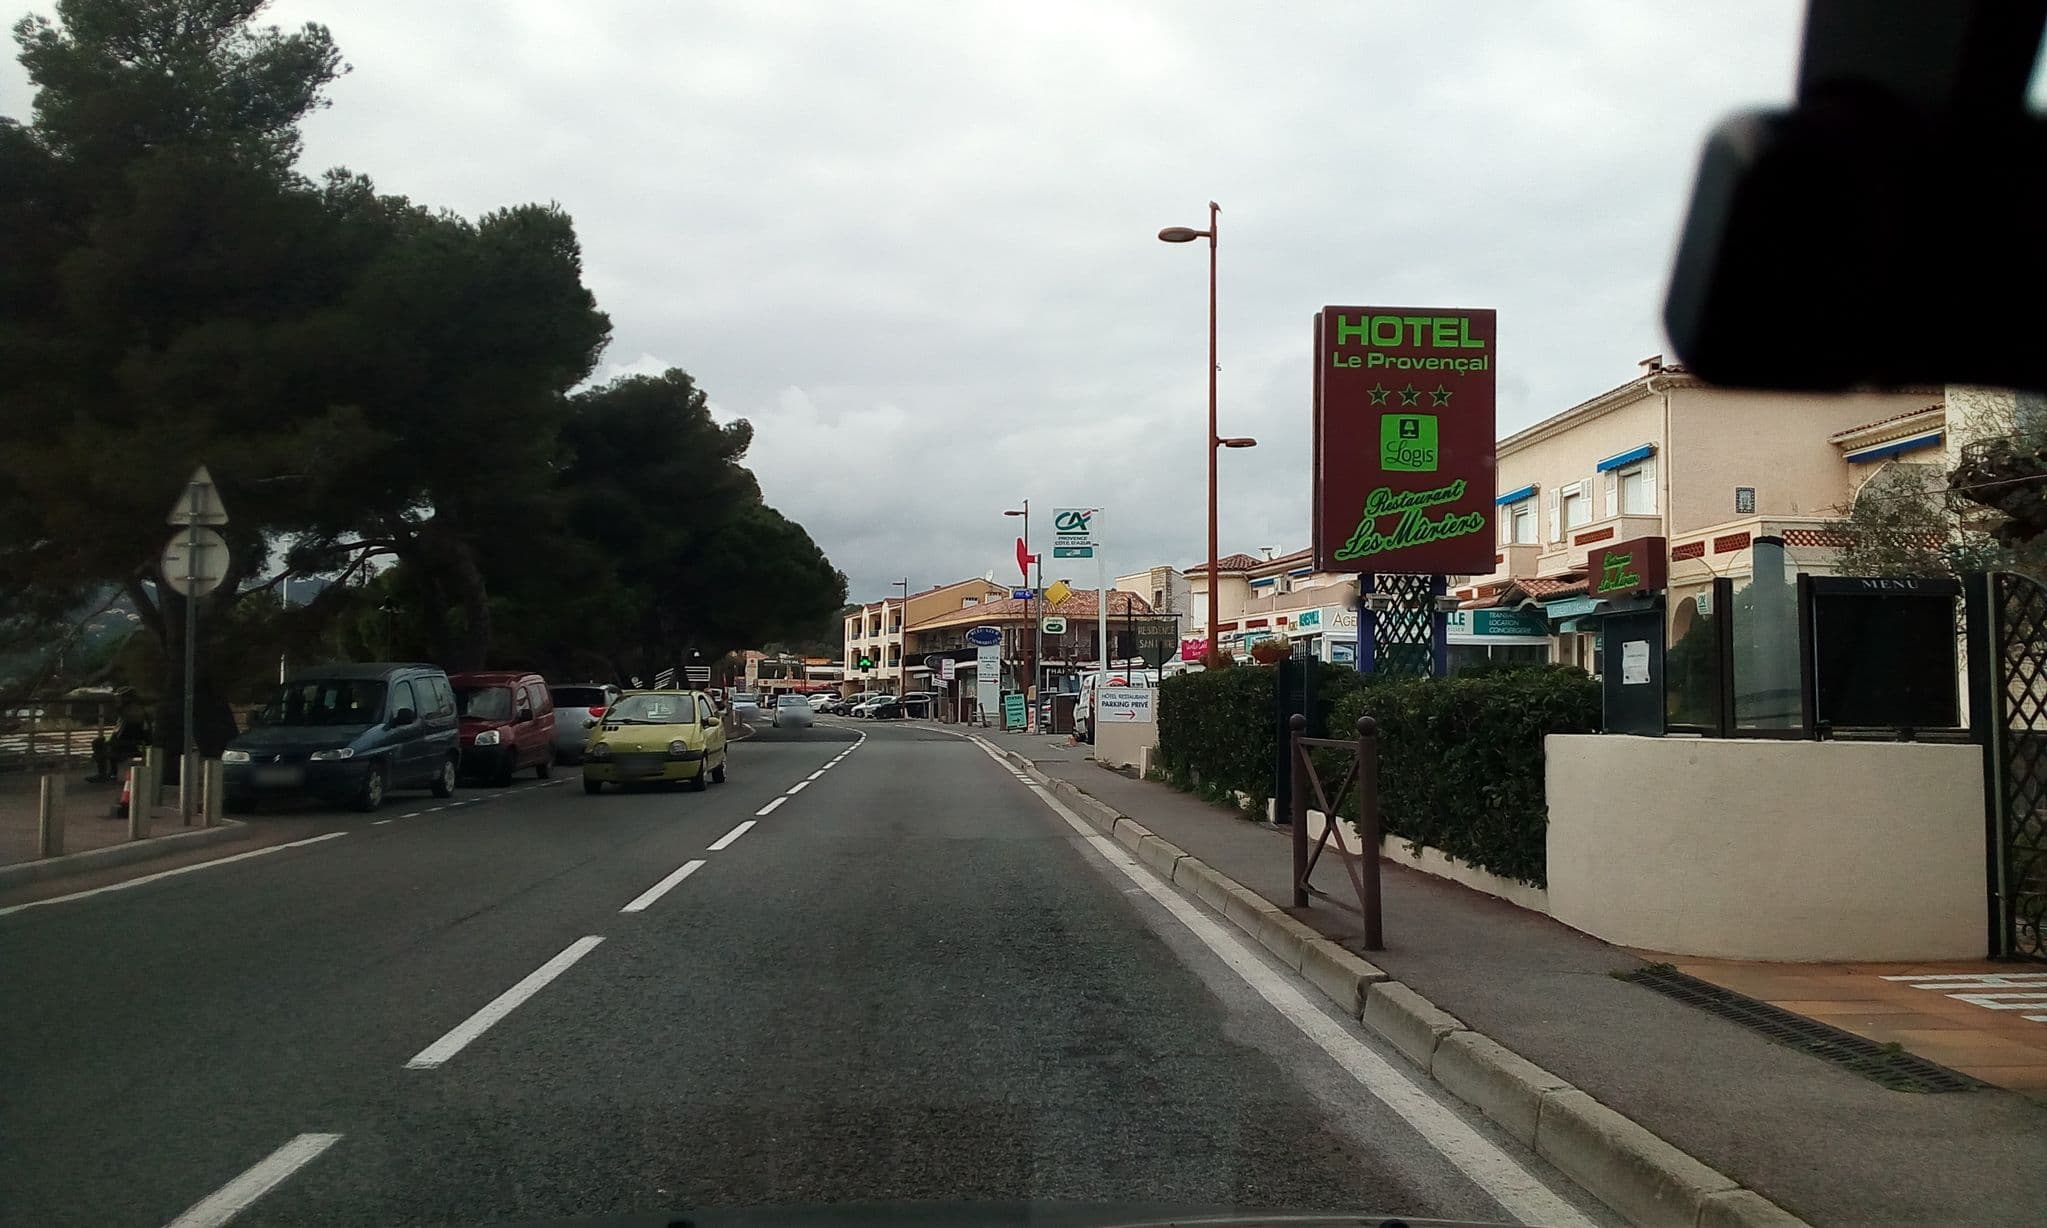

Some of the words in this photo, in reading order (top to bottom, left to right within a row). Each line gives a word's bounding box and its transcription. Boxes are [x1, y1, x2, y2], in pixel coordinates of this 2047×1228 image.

[1337, 315, 1485, 348] HOTEL
[1333, 351, 1362, 368] Le
[1367, 352, 1489, 376] Provençal
[1384, 440, 1434, 468] Logis
[1365, 479, 1467, 516] Restaurant
[1335, 517, 1385, 560] Les
[1386, 507, 1485, 550] Mûriers
[1862, 580, 1919, 589] MENU
